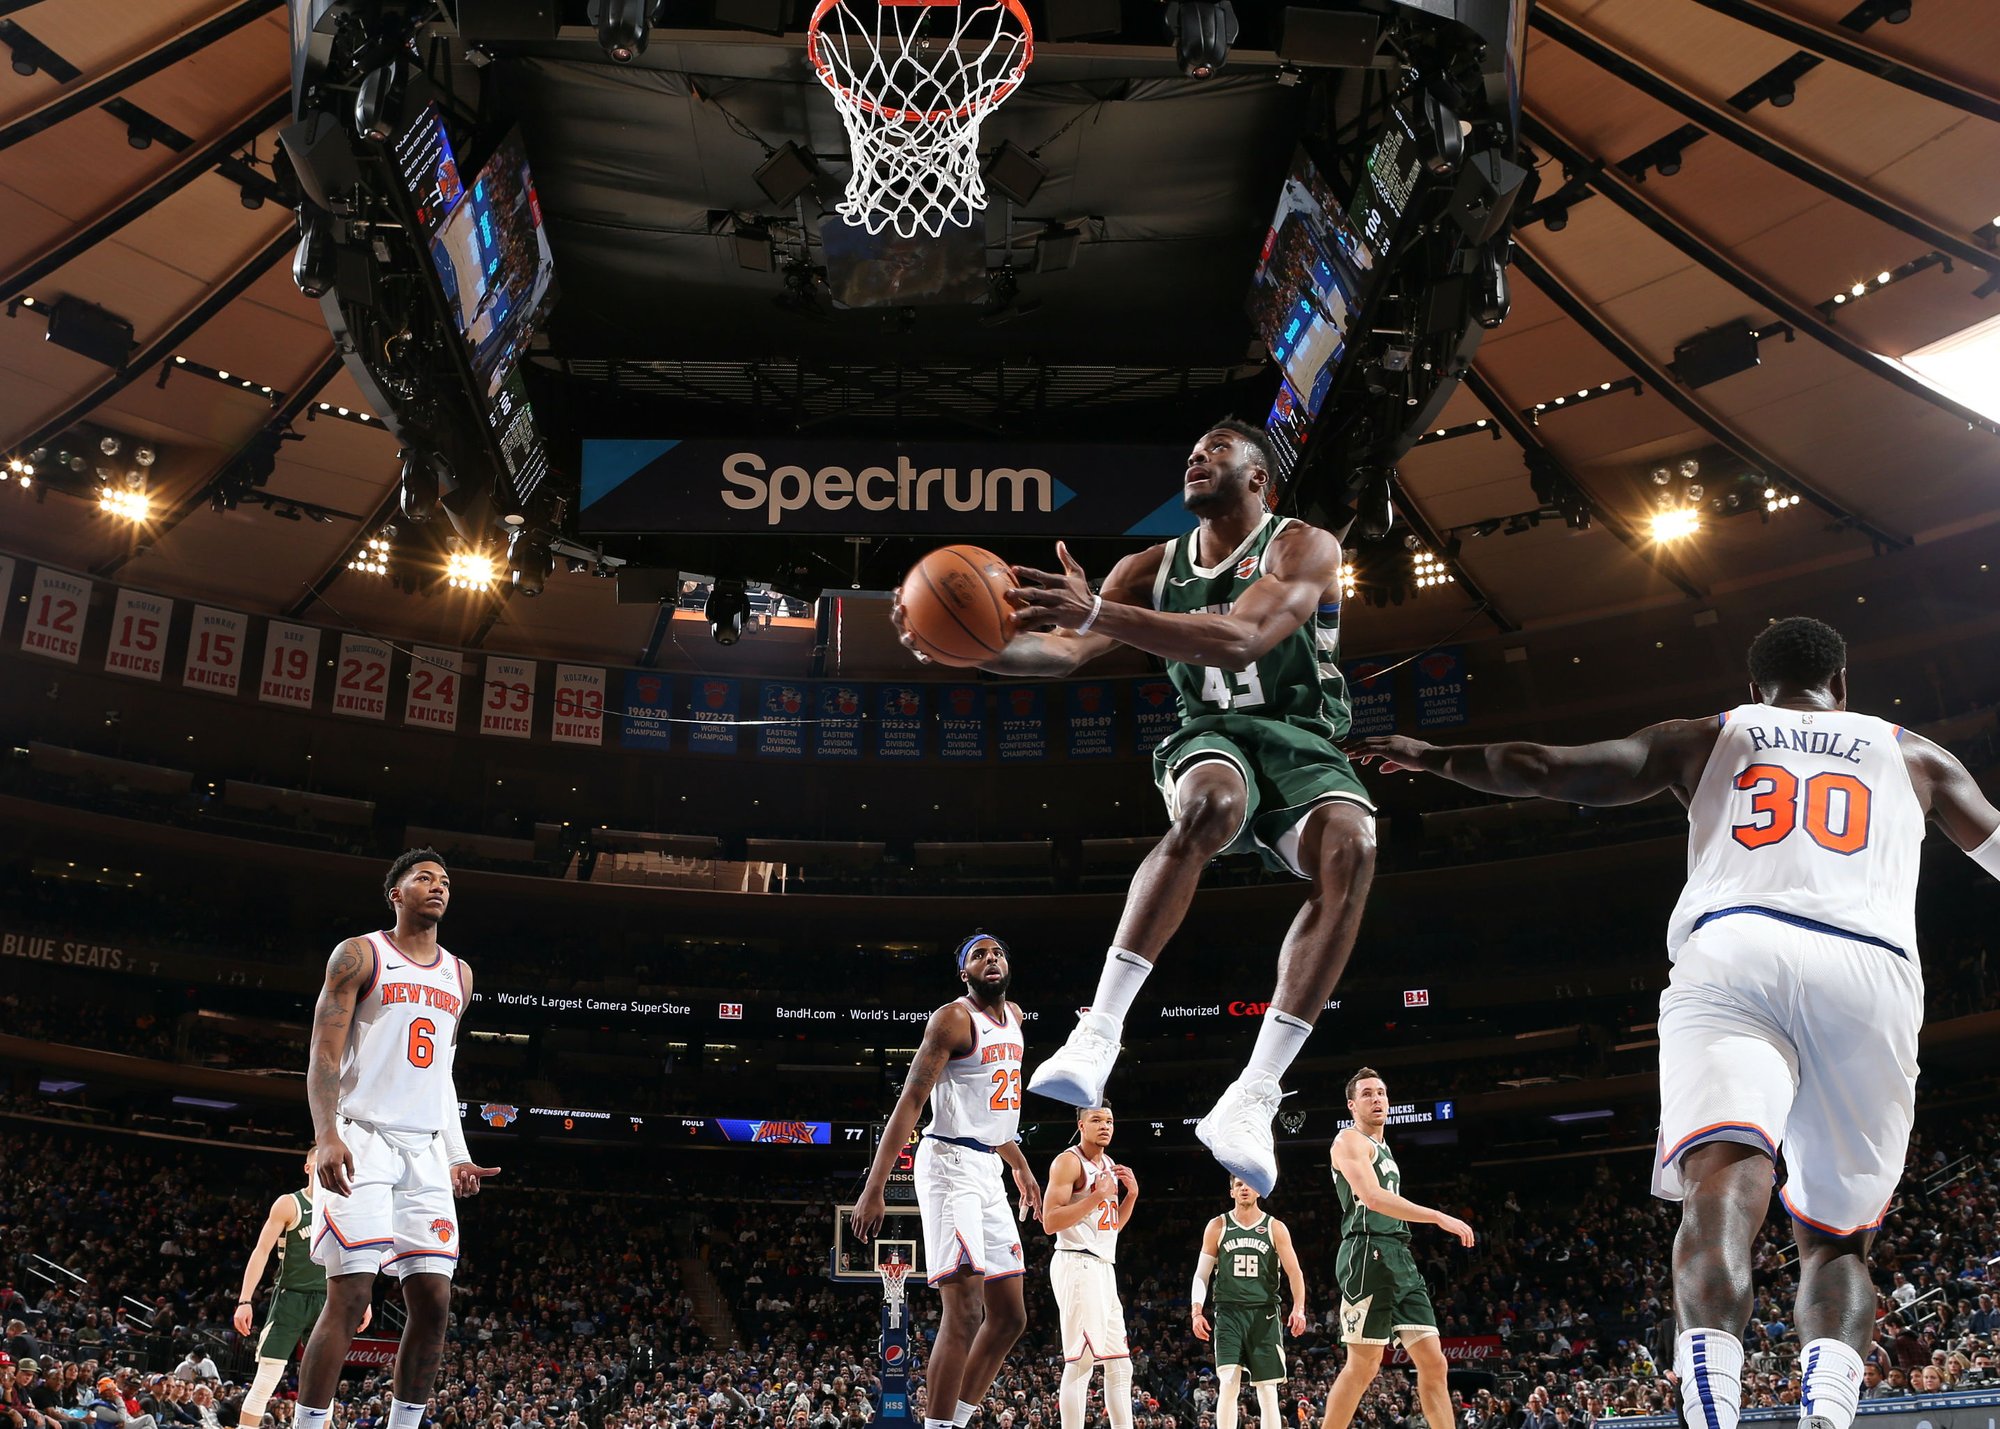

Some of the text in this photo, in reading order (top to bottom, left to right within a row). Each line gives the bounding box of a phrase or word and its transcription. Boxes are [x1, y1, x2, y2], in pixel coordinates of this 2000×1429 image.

[430, 182, 443, 207] 77
[1365, 208, 1381, 240] 100
[499, 390, 512, 416] 100
[720, 452, 1052, 525] Spectrum
[37, 594, 78, 634] 12
[120, 615, 160, 651] 15
[26, 630, 78, 656] KNICKS
[197, 631, 236, 667] 15
[109, 651, 160, 674] KNICKS
[271, 646, 308, 680] 19
[187, 667, 236, 689] KNICKS
[340, 658, 386, 693] 22
[262, 681, 310, 702] KNICKS
[413, 671, 454, 705] 24
[1202, 661, 1265, 710] 43
[1419, 684, 1462, 698] 2012-13
[487, 680, 530, 712] 33
[1352, 692, 1392, 706] 998-99
[1424, 697, 1458, 708] ATLANTIC
[336, 694, 383, 713] KNICKS
[555, 688, 603, 719] 613
[409, 705, 454, 724] KNICKS
[628, 706, 668, 718] 1969-70
[695, 711, 734, 722] 1972-73
[1137, 712, 1179, 724] 1992-93
[1353, 706, 1387, 717] EASTERN
[1426, 706, 1457, 716] DIVISION
[483, 715, 529, 732] KNICKS
[634, 720, 659, 728] WORLD
[1071, 717, 1112, 727] 1988-89
[1352, 715, 1395, 726] ONFERENCE
[1421, 714, 1464, 726] CHAMPIONS
[555, 722, 600, 739] KNICKS
[625, 728, 666, 738] CHAMPIONS
[766, 729, 797, 737] EASTERN
[945, 732, 979, 740] ATLANTIC
[1075, 729, 1108, 737] ATLANTIC
[1141, 725, 1173, 734] ATLANTIC
[693, 732, 733, 742] CHAMPIONS
[767, 737, 796, 745] DIVISION
[1076, 738, 1106, 746] DIVISION
[761, 745, 801, 754] CHAMPIONS
[817, 747, 858, 756] CHAMPIONS
[879, 748, 920, 756] CHAMPIONS
[1000, 741, 1046, 749] CONFERENCE
[1071, 746, 1112, 755] CHAMPIONS
[1747, 726, 1871, 765] RANDLE
[942, 749, 982, 757] CHAMPIONS
[1002, 749, 1042, 757] CHAMPIONS
[1732, 763, 1872, 856] 30
[2, 933, 123, 969] BLUE SEATS
[381, 982, 461, 1020] NEW YORK
[498, 993, 538, 1006] World's
[541, 996, 582, 1010] Largest
[586, 999, 627, 1012] Camera
[631, 1001, 691, 1015] SuperStore
[776, 1007, 836, 1020] BandH.com
[850, 1009, 889, 1021] World's
[1161, 1004, 1220, 1018] Authorized
[407, 1016, 436, 1069] 6
[981, 1043, 1006, 1065] NEW
[990, 1069, 1021, 1110] 23
[529, 1107, 611, 1120] OFFENSIVE REBOUNDS
[564, 1118, 574, 1130] 9
[633, 1124, 639, 1132] 1
[689, 1127, 696, 1135] 3
[755, 1121, 814, 1142] KNICKS
[844, 1128, 864, 1140] 77
[1154, 1129, 1161, 1137] 4
[1098, 1200, 1119, 1231] 20
[1223, 1237, 1270, 1255] MILWAUKEE
[1233, 1254, 1259, 1277] 26
[885, 1401, 904, 1409] HSS
